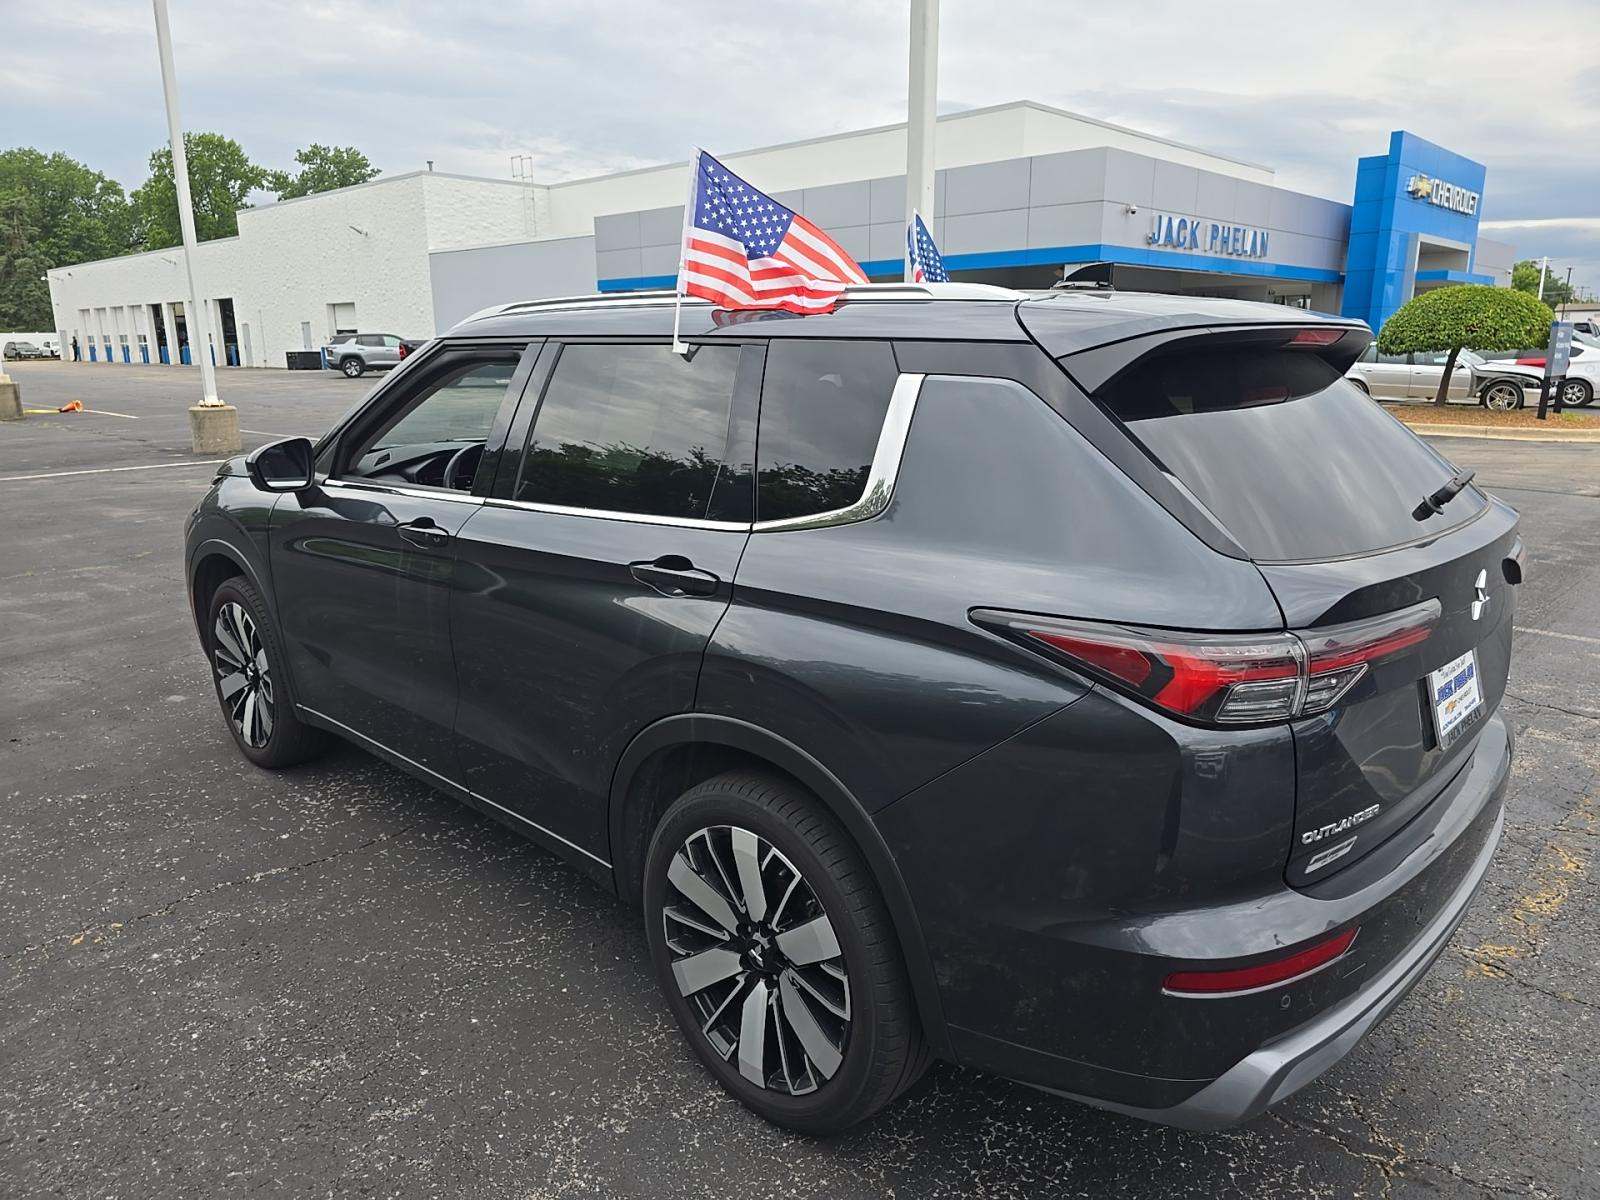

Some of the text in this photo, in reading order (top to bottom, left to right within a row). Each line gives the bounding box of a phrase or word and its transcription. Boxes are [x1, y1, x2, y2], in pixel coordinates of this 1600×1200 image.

[1431, 177, 1480, 216] CHEVROLET
[1150, 214, 1269, 258] JACK PHELAN
[1301, 803, 1380, 845] OUTLANDER
